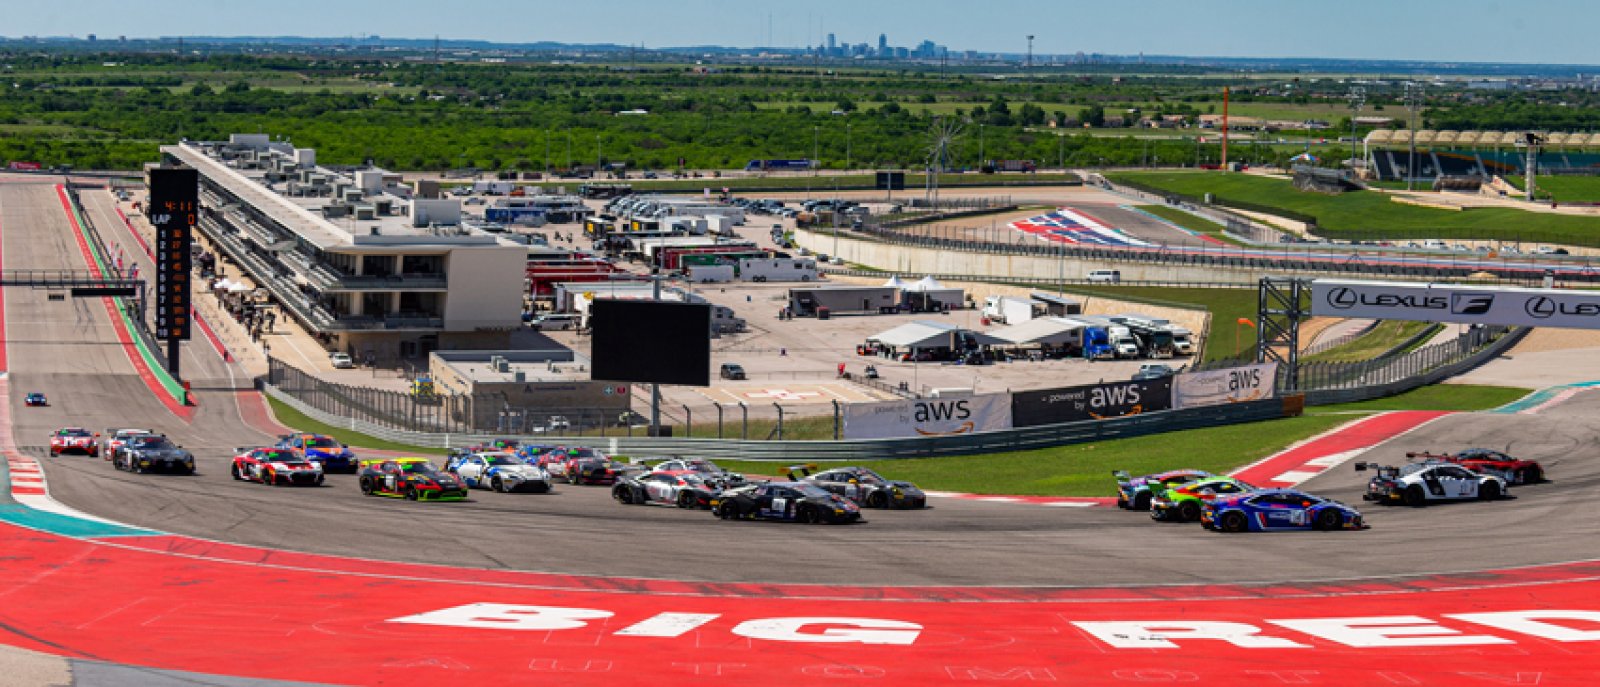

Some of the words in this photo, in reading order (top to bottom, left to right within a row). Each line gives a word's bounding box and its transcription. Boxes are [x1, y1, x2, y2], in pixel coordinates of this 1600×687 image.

[165, 200, 192, 211] 4:11
[152, 214, 171, 224] LAP
[160, 240, 166, 249] 2
[1361, 293, 1448, 309] LEXUS
[1560, 302, 1600, 316] LE
[1229, 368, 1260, 391] aws
[1049, 391, 1085, 403] powered
[1090, 384, 1140, 407] aws
[914, 399, 971, 422] aws
[1074, 402, 1085, 411] by
[385, 602, 924, 645] BIG
[1069, 610, 1600, 649] RED
